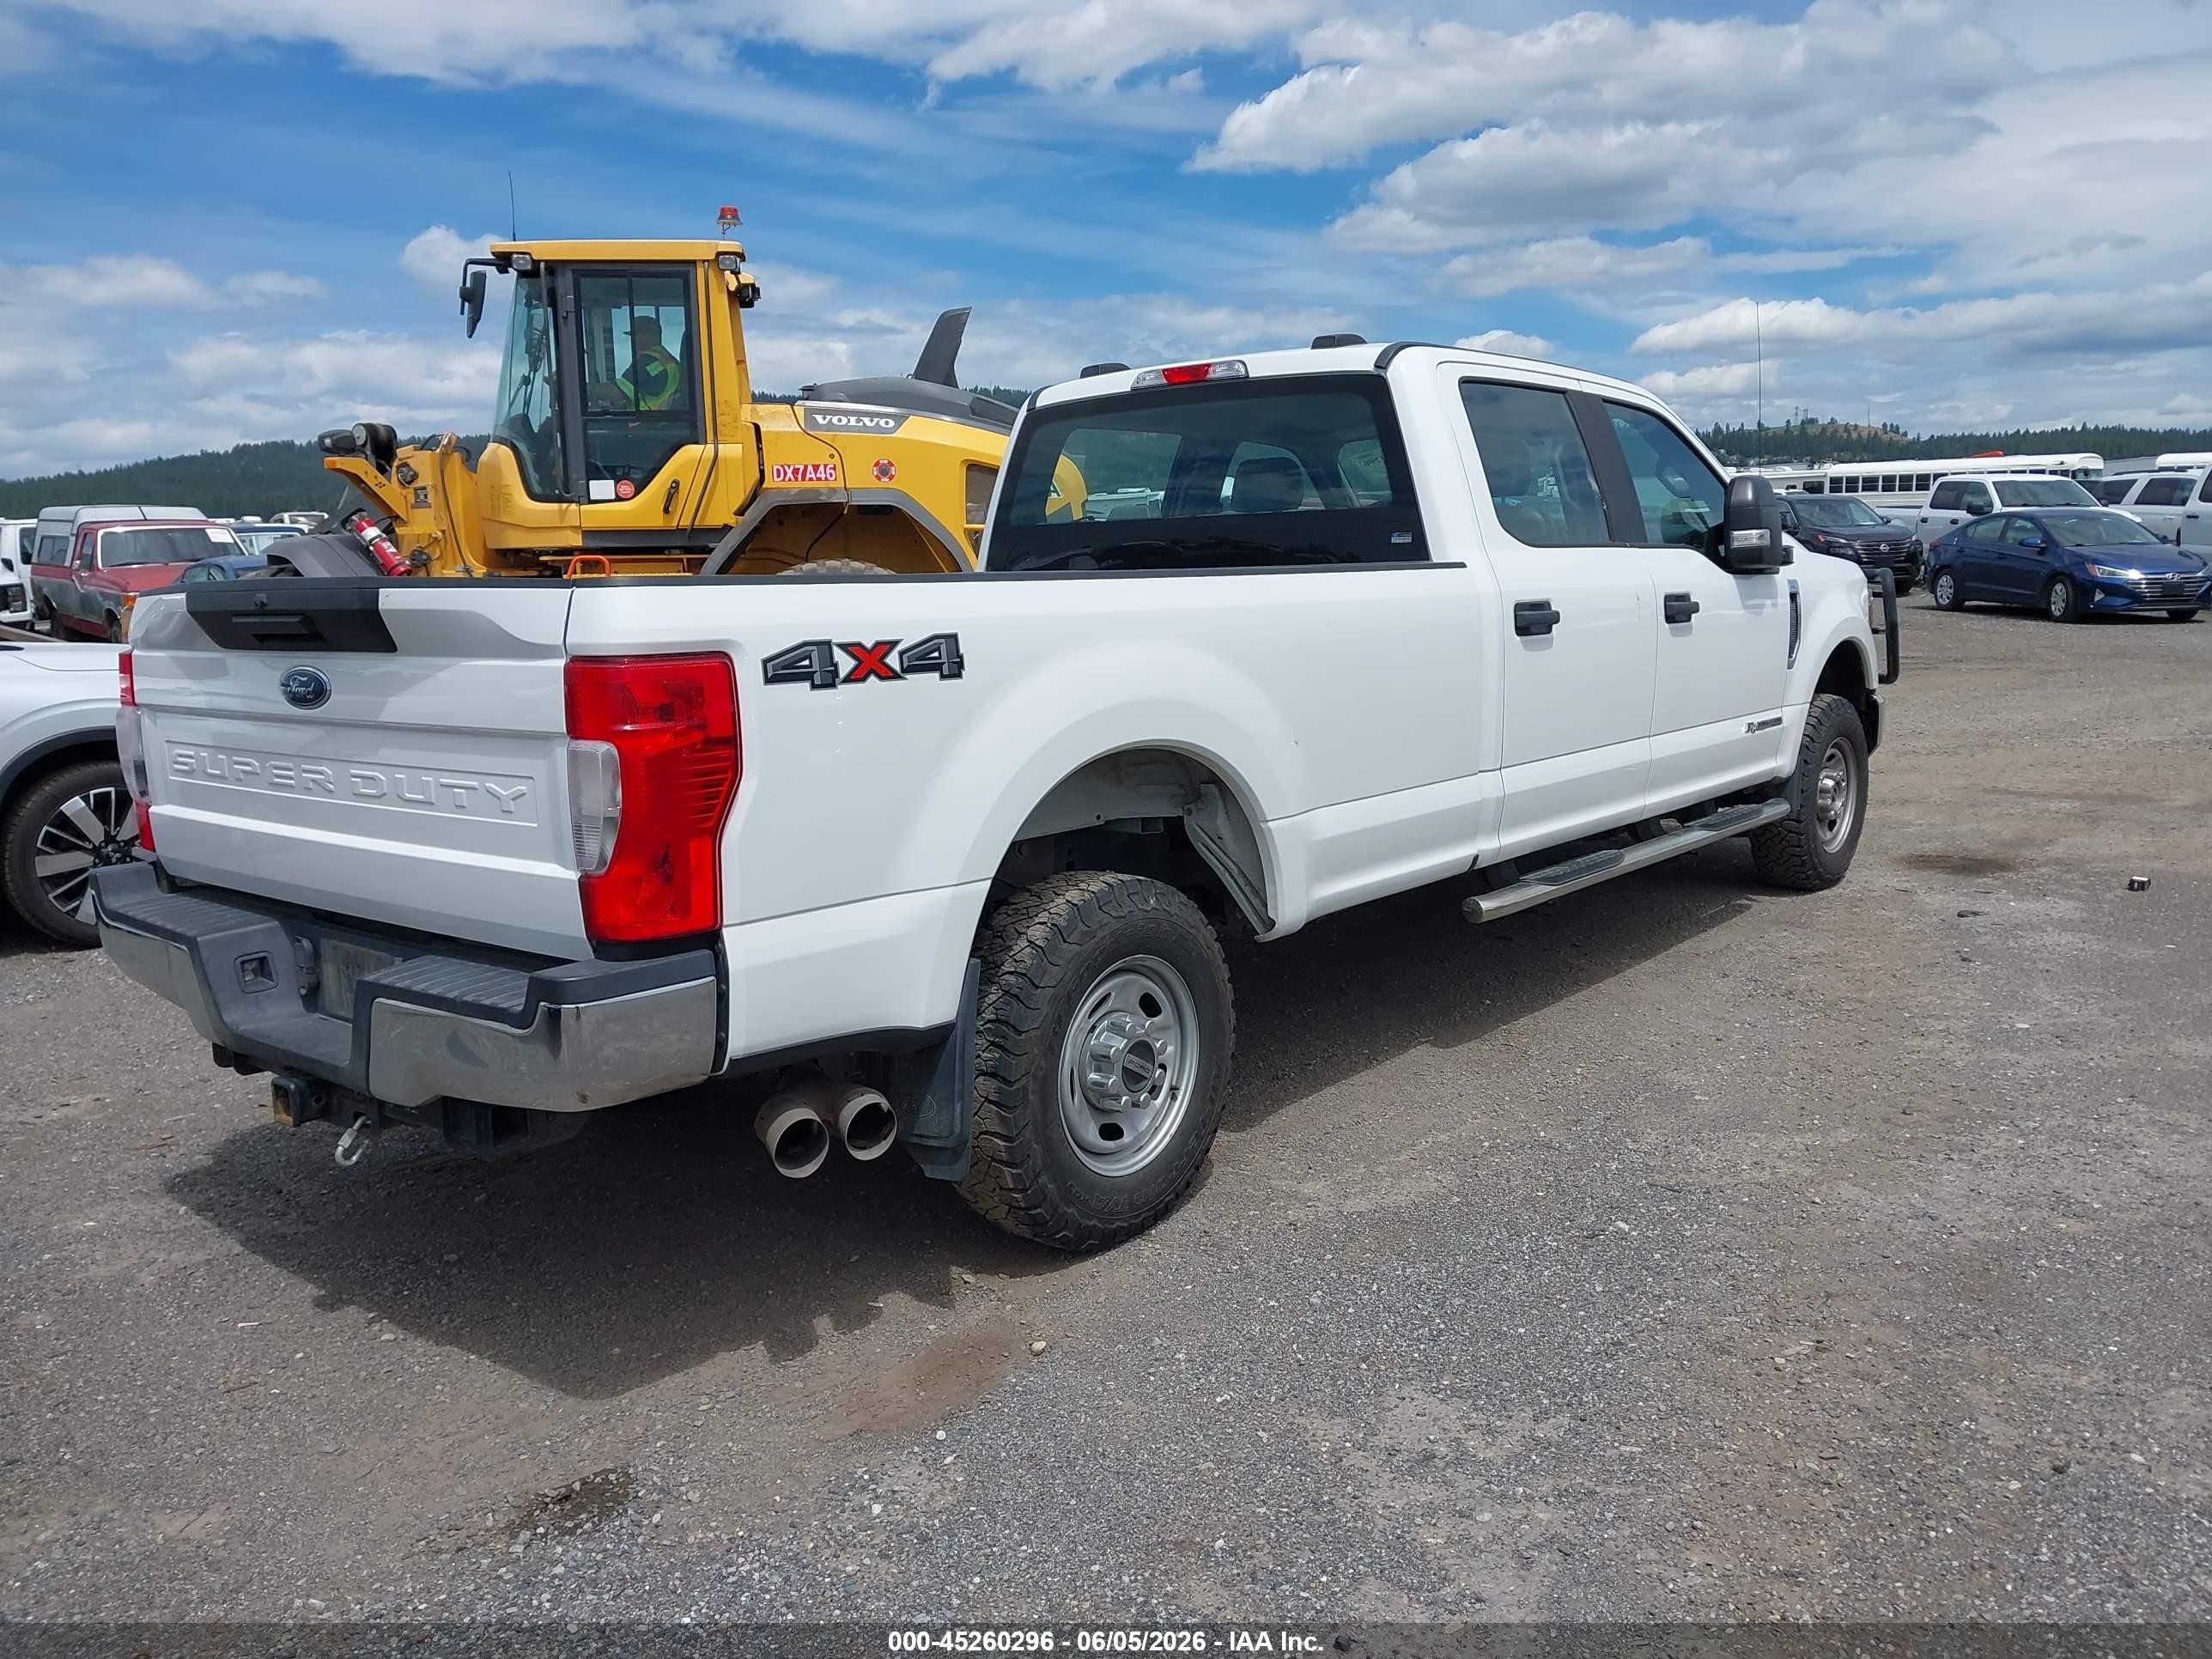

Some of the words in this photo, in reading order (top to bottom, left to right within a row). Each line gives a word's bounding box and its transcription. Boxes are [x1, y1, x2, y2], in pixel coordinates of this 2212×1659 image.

[811, 414, 896, 428] VOLVO
[773, 464, 836, 482] DX7A46
[288, 675, 315, 700] Ford
[173, 749, 336, 793] SUPER
[349, 769, 527, 815] DUTY
[1127, 1059, 1151, 1074] FORD
